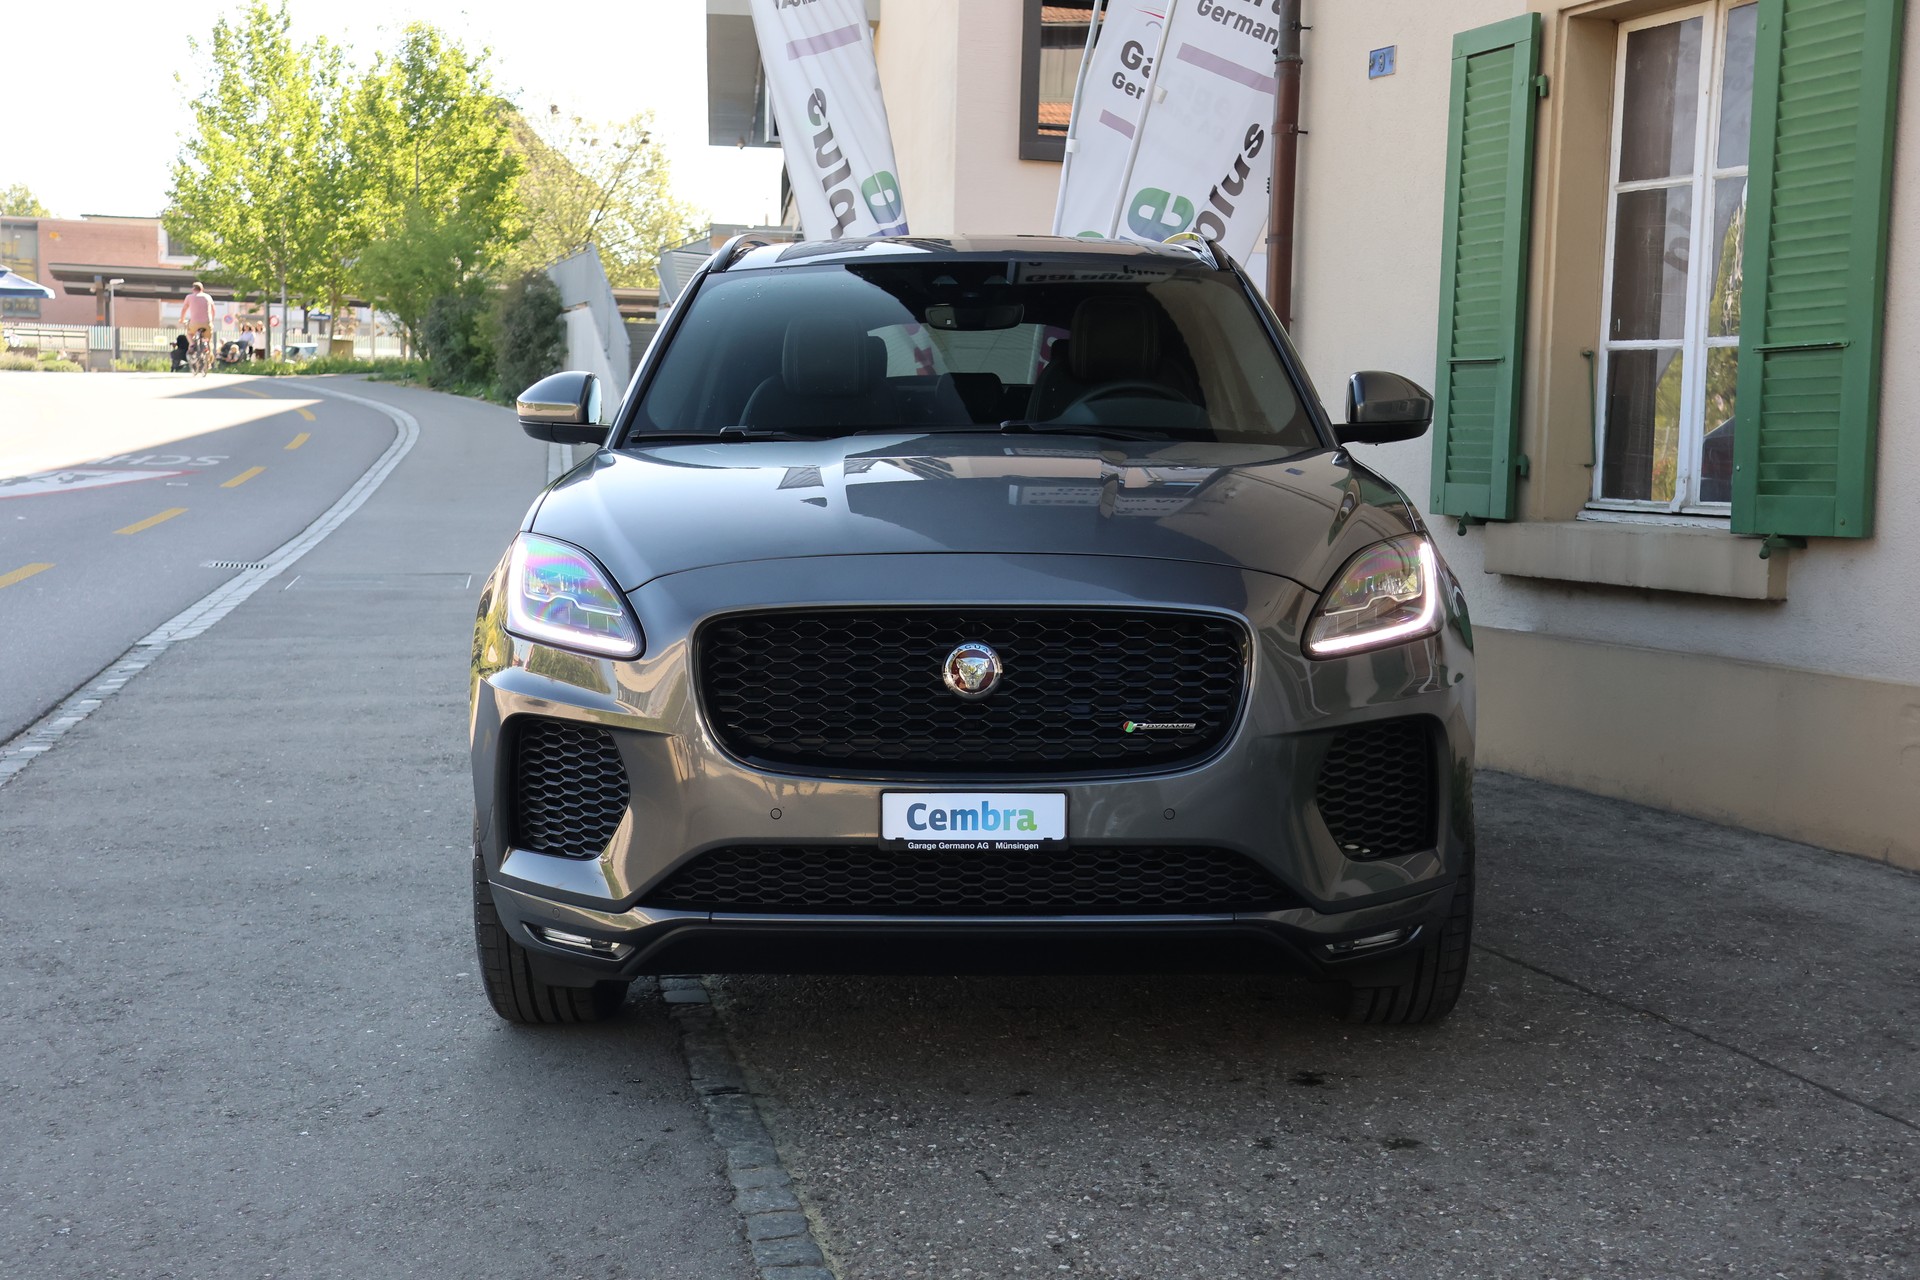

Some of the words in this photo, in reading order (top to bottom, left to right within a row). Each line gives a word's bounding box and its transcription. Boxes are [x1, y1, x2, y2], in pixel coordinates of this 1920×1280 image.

[1197, 0, 1279, 46] German
[1111, 71, 1146, 100] Ger
[1127, 187, 1195, 243] e
[906, 800, 1038, 831] Cembra
[907, 842, 937, 851] Garage
[938, 842, 975, 850] Germano
[976, 842, 989, 850] AG
[995, 842, 1039, 851] Münsingen
